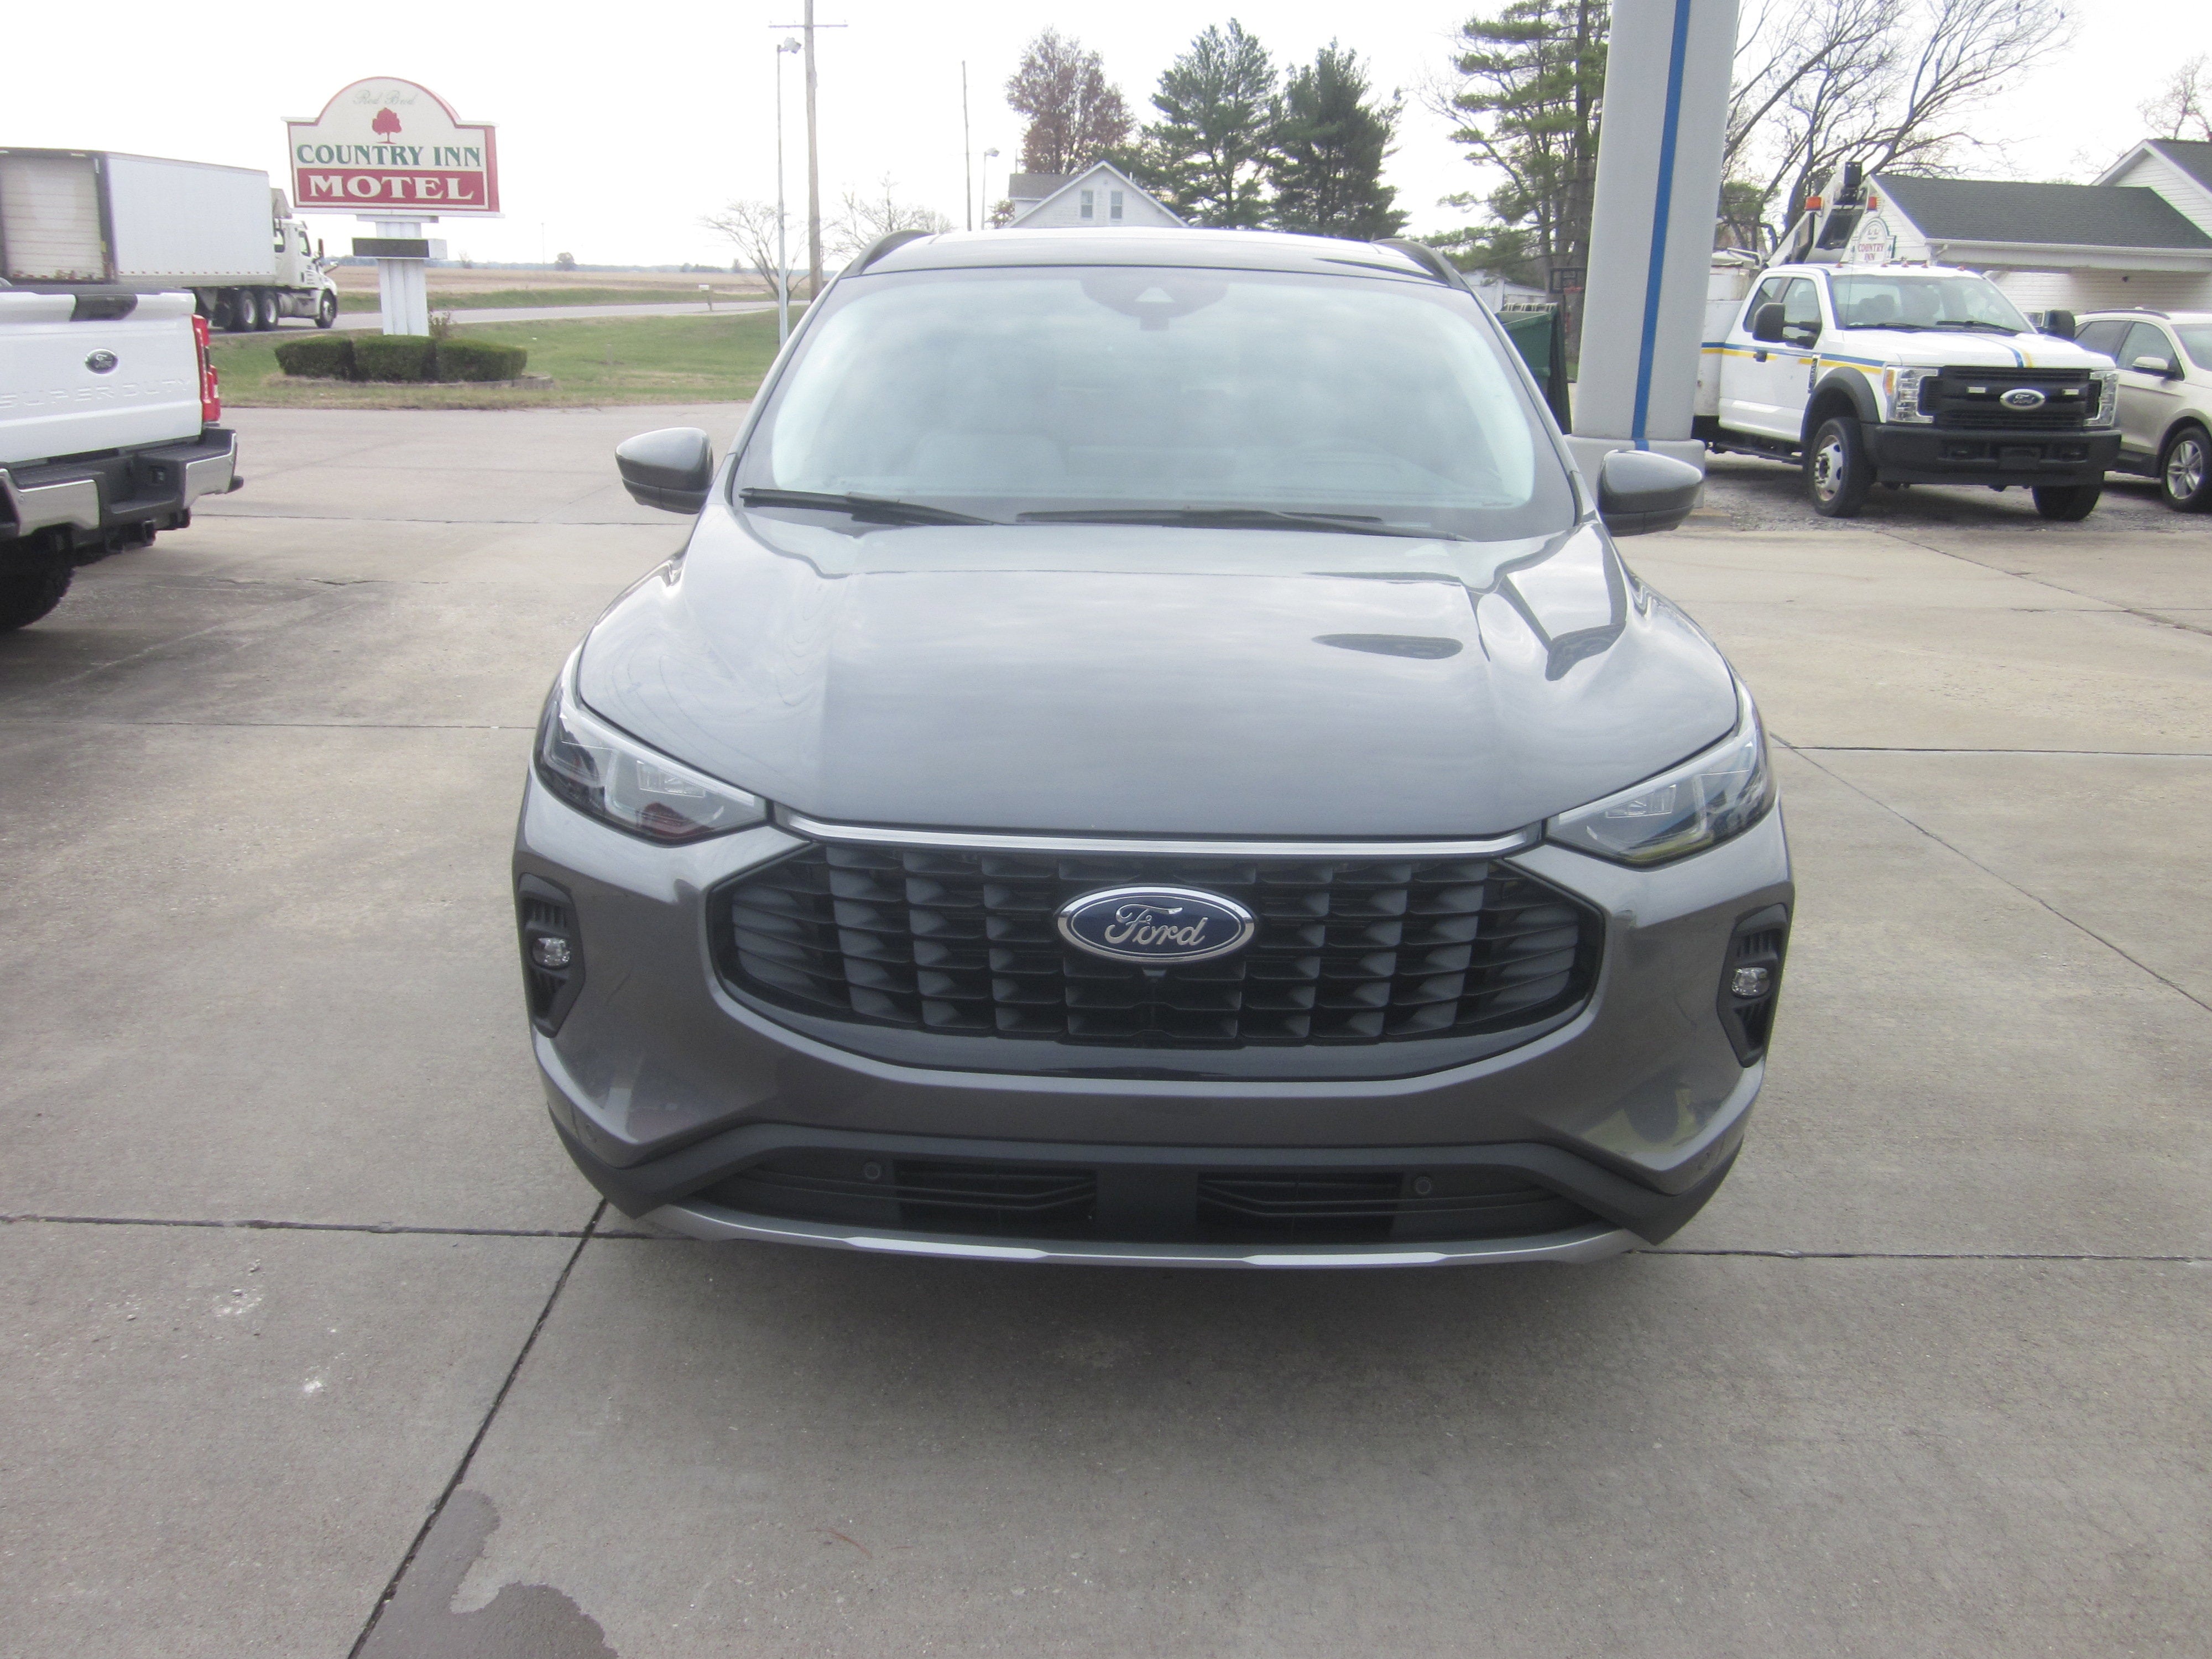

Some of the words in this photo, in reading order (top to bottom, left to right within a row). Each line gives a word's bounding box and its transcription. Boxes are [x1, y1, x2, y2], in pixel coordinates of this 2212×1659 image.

[353, 90, 383, 105] Red
[384, 90, 418, 105] Bud
[296, 144, 424, 166] COUNTRY
[433, 146, 481, 166] INN
[308, 175, 474, 200] MOTEL
[1104, 904, 1208, 946] Ford
